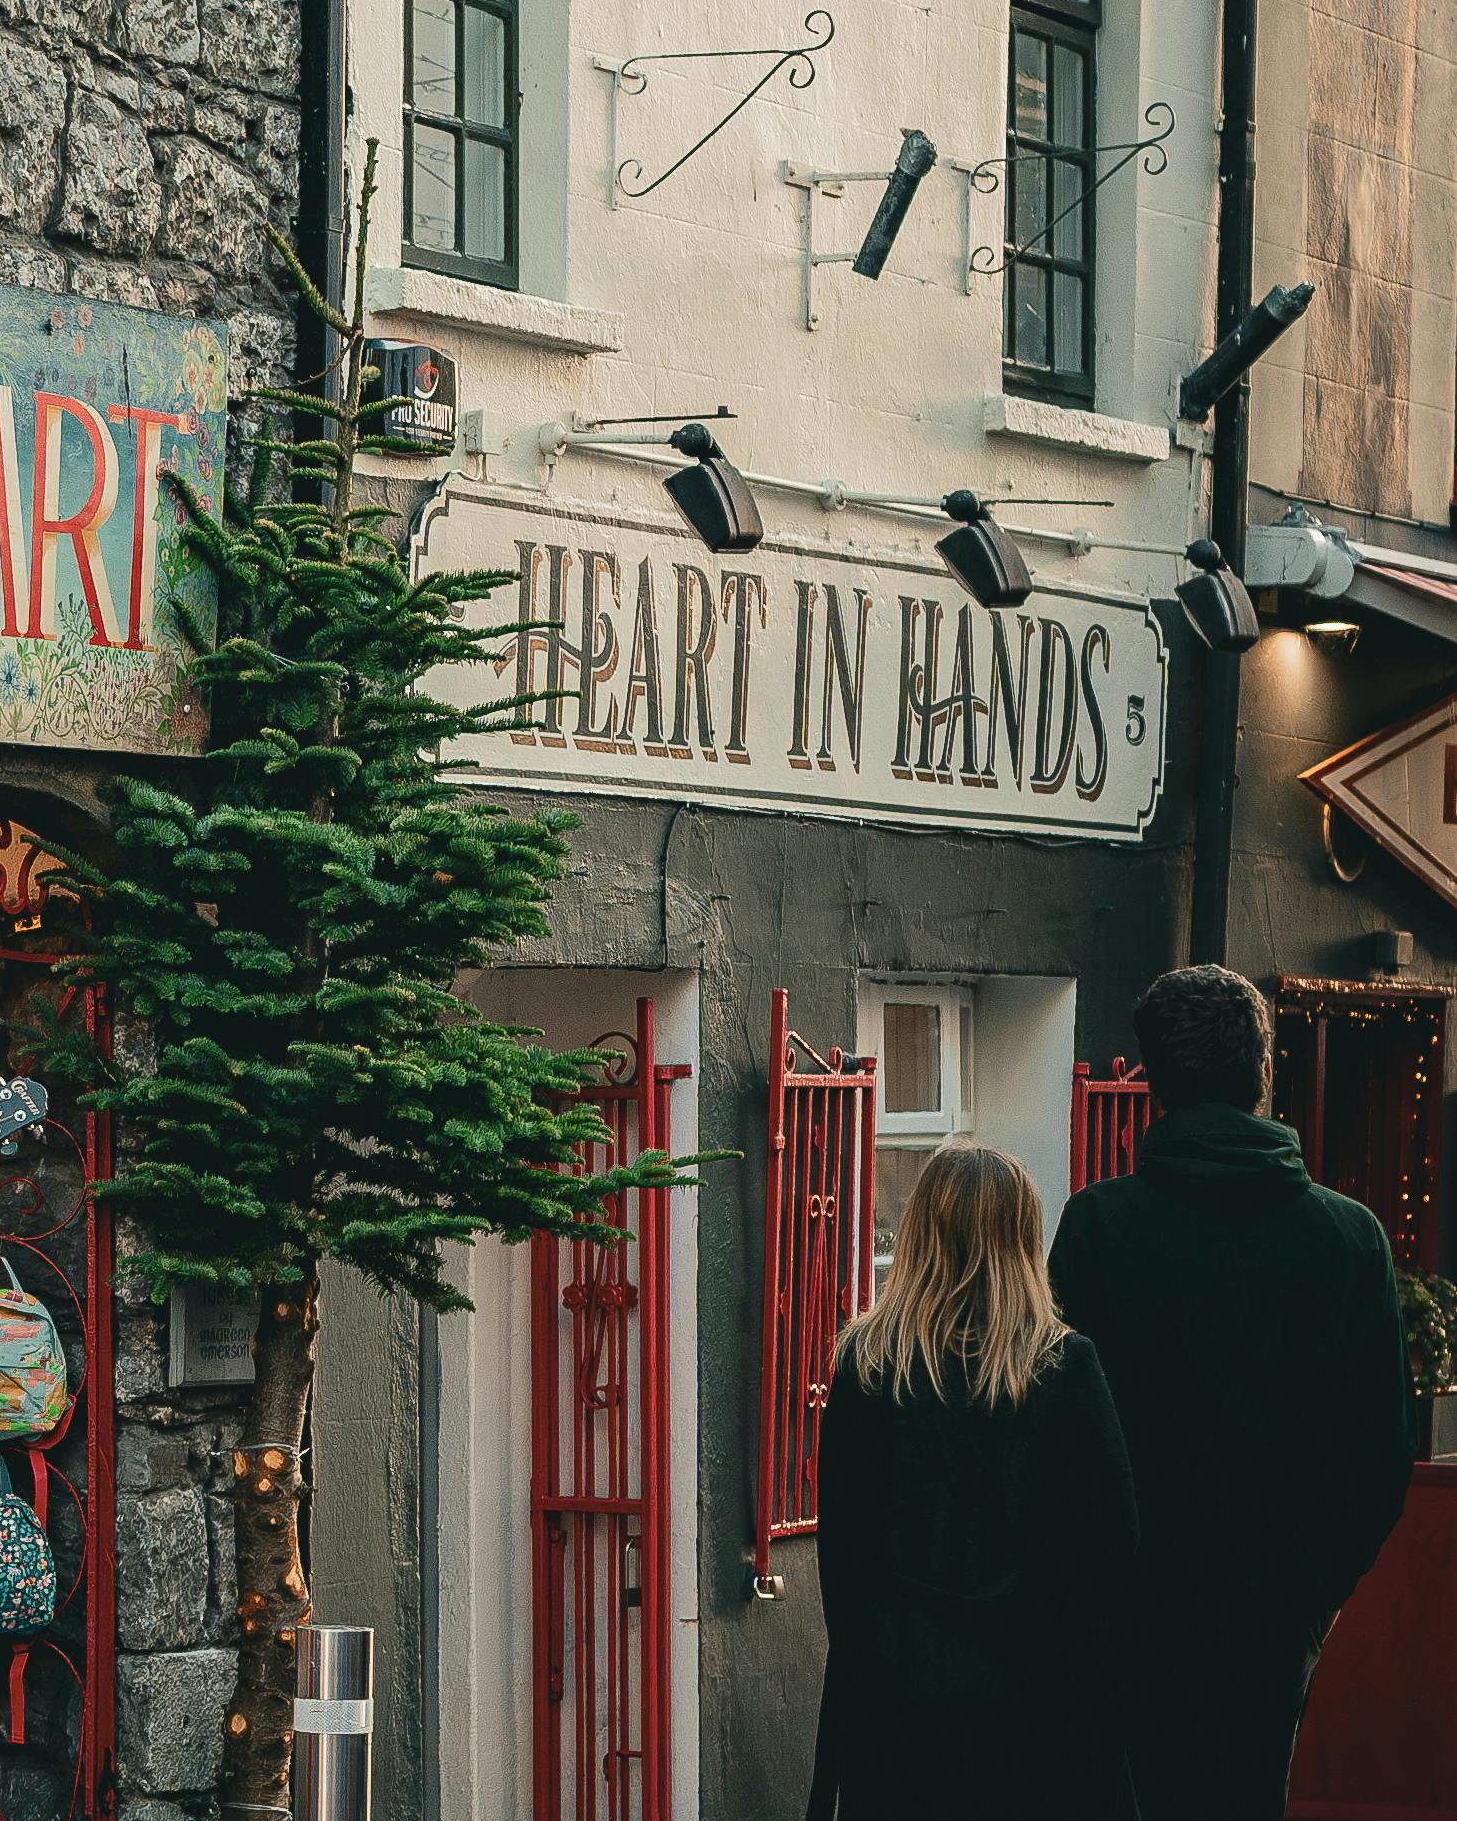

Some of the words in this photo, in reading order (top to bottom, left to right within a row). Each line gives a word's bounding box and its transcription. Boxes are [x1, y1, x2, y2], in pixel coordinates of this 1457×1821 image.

[414, 398, 454, 433] SECURITY
[497, 540, 768, 766] HEART
[787, 578, 873, 774] IN
[891, 594, 1112, 802] HANDS
[1124, 694, 1148, 746] 5
